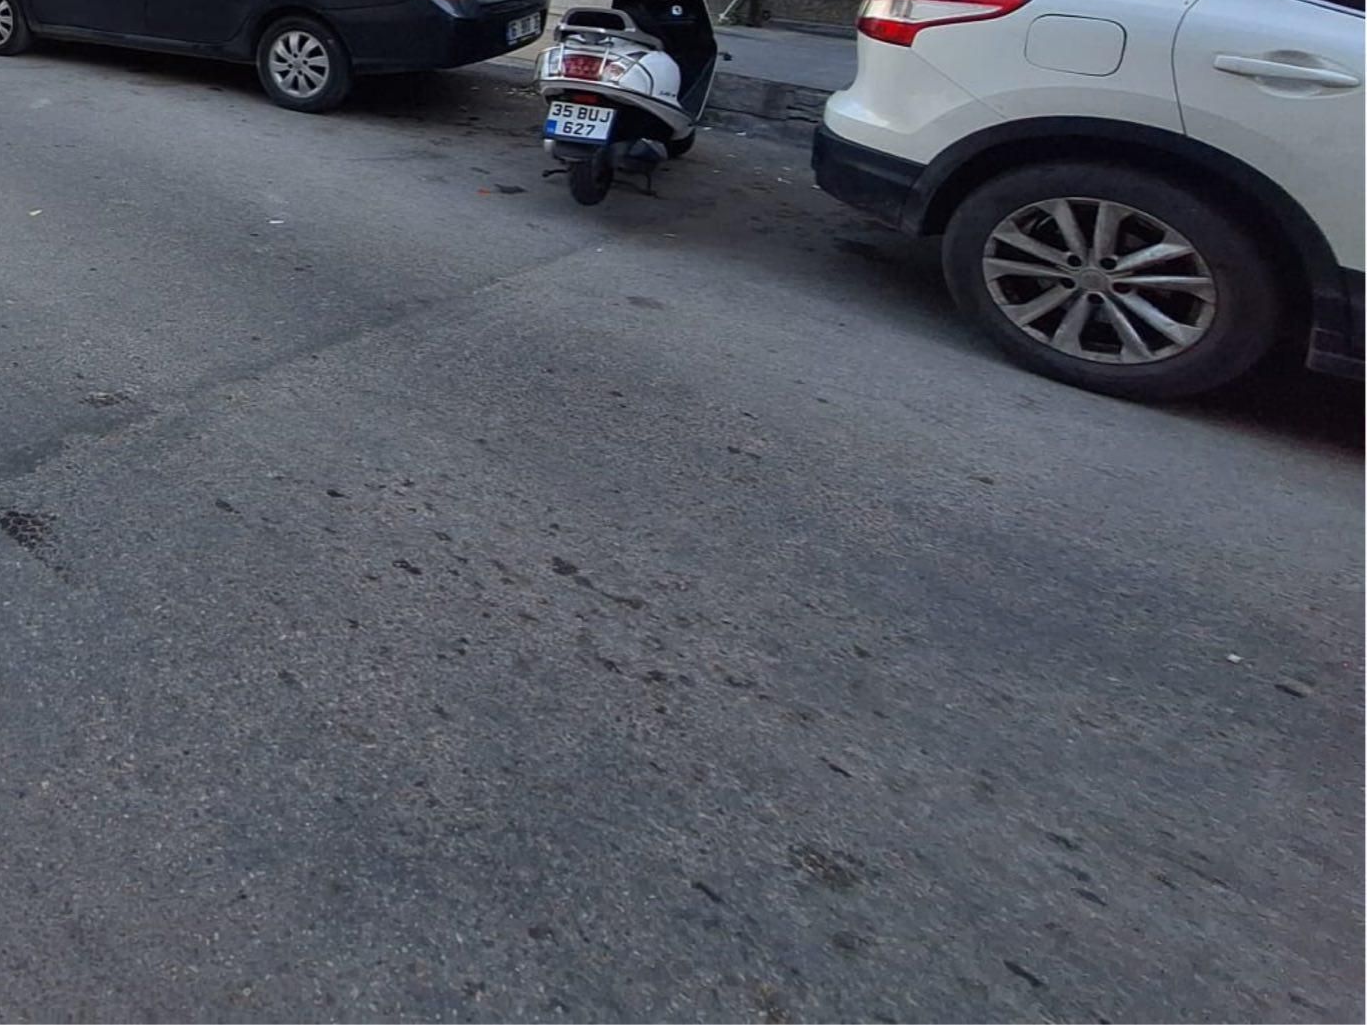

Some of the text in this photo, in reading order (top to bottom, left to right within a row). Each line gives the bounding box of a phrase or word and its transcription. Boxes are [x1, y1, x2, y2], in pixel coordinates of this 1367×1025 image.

[552, 104, 612, 124] 35 BUJ
[562, 121, 596, 137] 627
